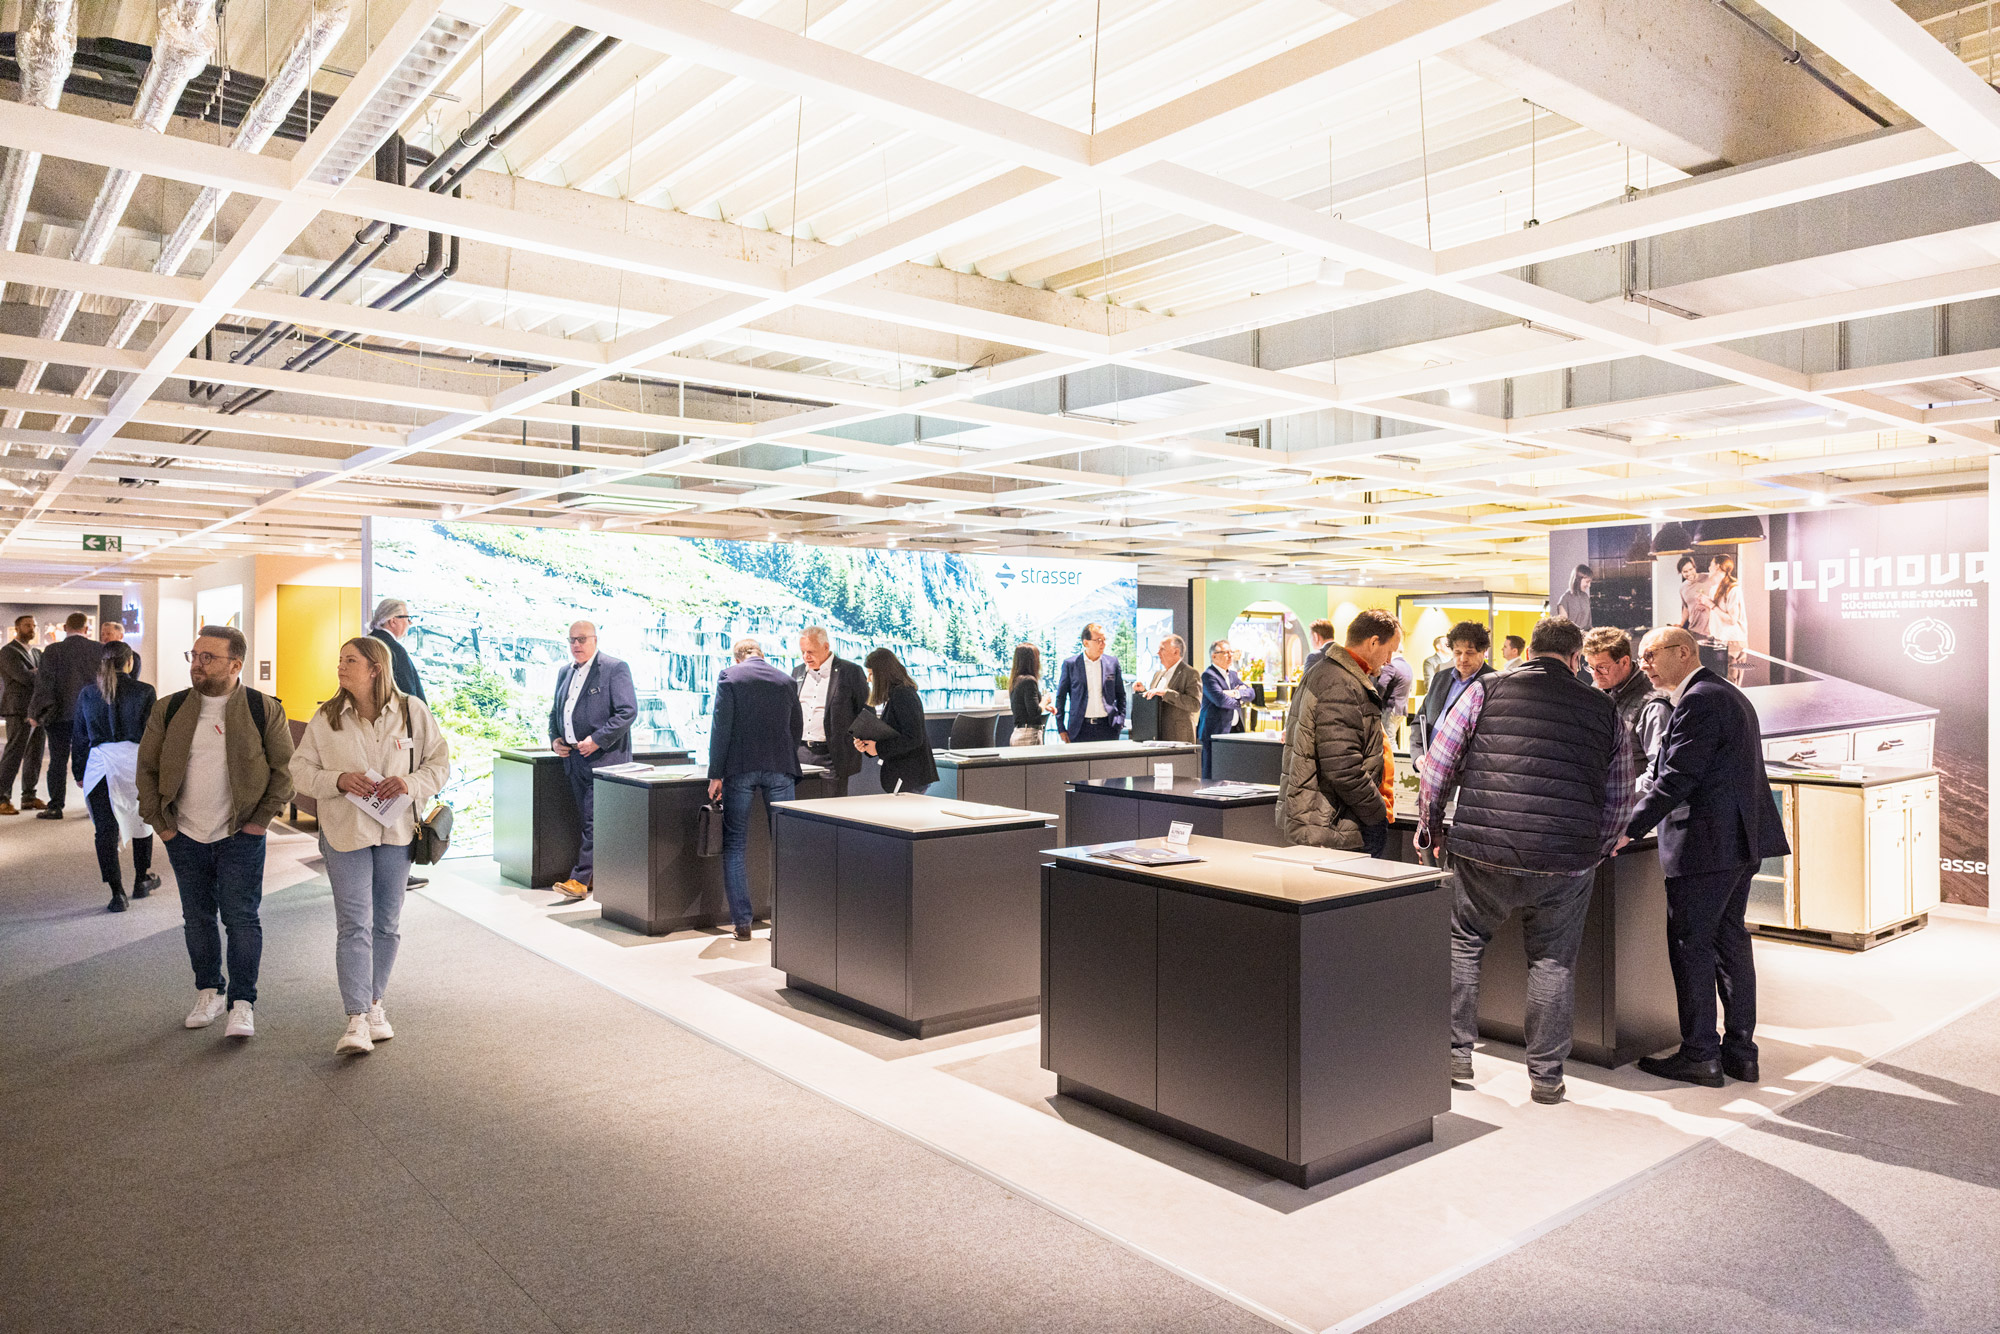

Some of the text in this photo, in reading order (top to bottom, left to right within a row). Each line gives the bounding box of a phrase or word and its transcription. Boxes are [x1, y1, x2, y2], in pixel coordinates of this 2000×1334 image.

[1021, 568, 1082, 585] strasser
[1841, 589, 1973, 601] DIE ERSTE RE-STONING
[1841, 598, 1978, 610] KÜCHENARBEITSPLATTE
[1841, 609, 1900, 619] WELTWEIT.
